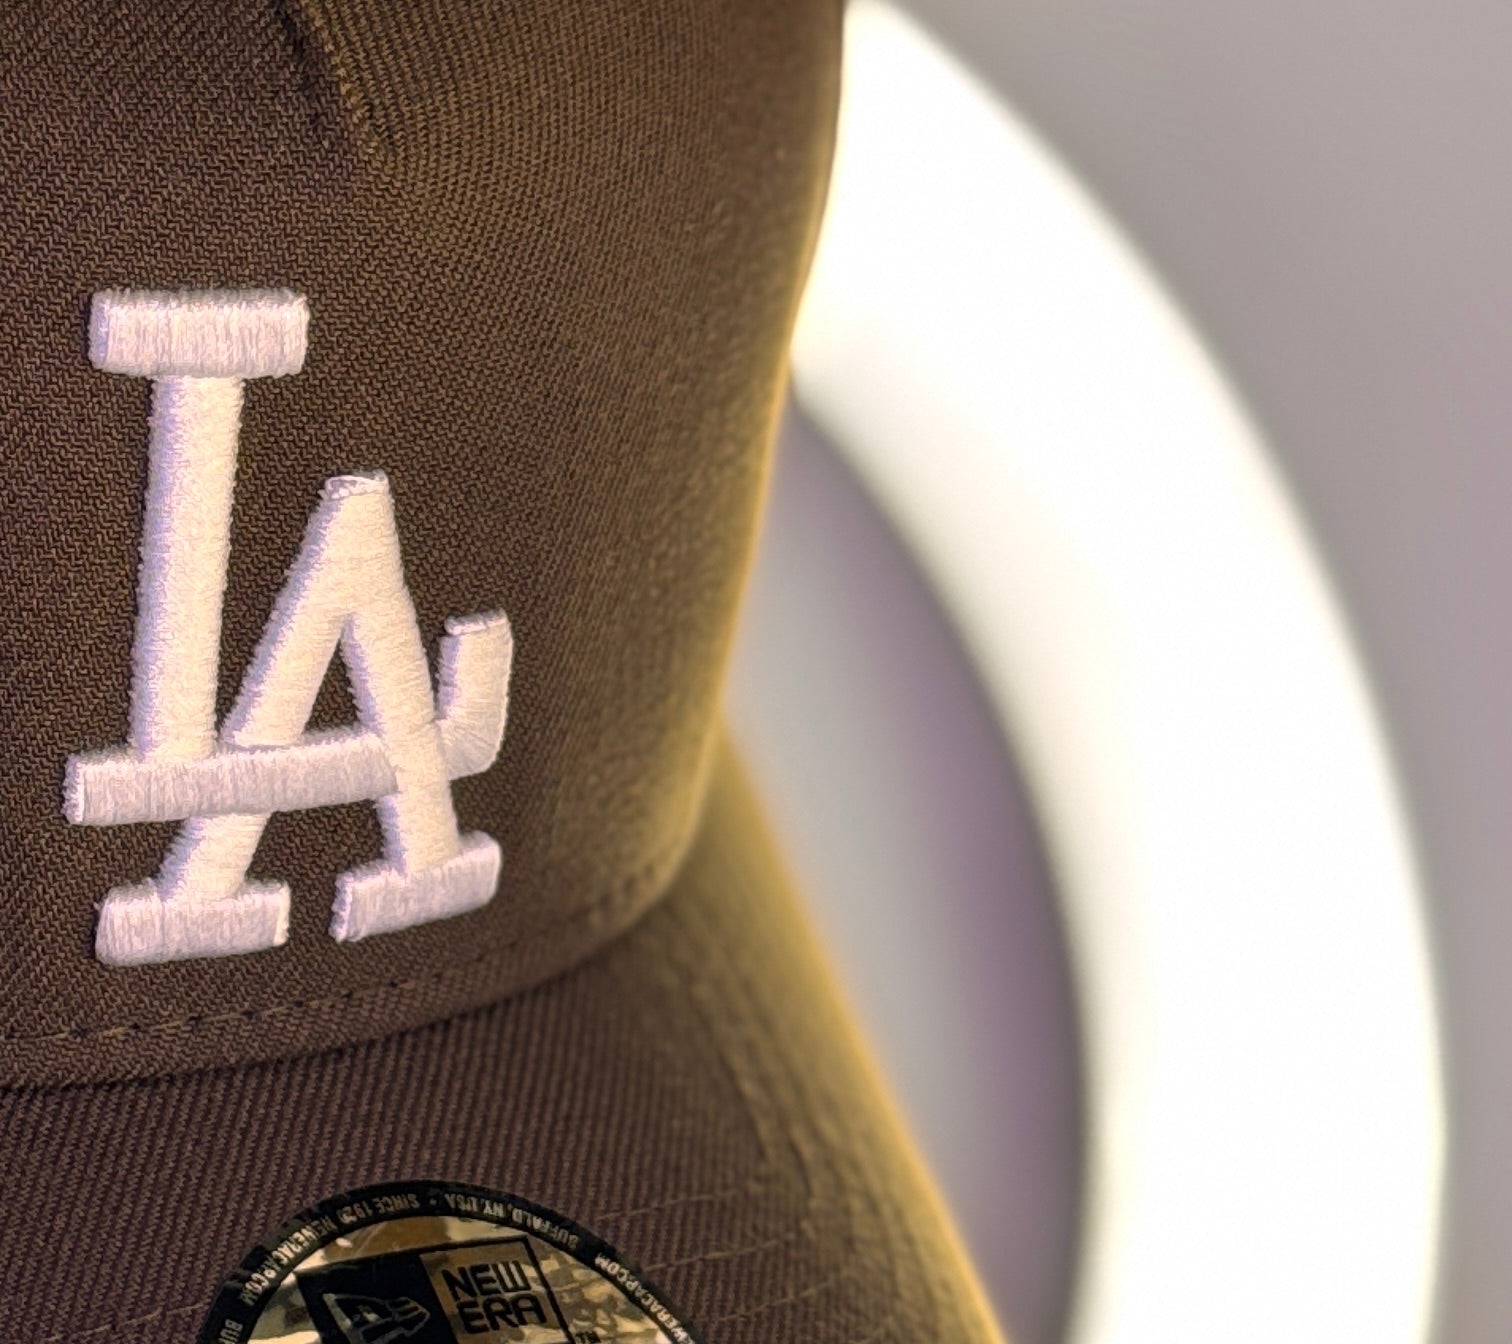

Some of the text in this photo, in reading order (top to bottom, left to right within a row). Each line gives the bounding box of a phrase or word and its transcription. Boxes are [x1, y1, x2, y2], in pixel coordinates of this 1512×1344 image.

[62, 286, 514, 967] LA
[441, 1260, 532, 1302] NEW
[455, 1293, 547, 1335] ERA
